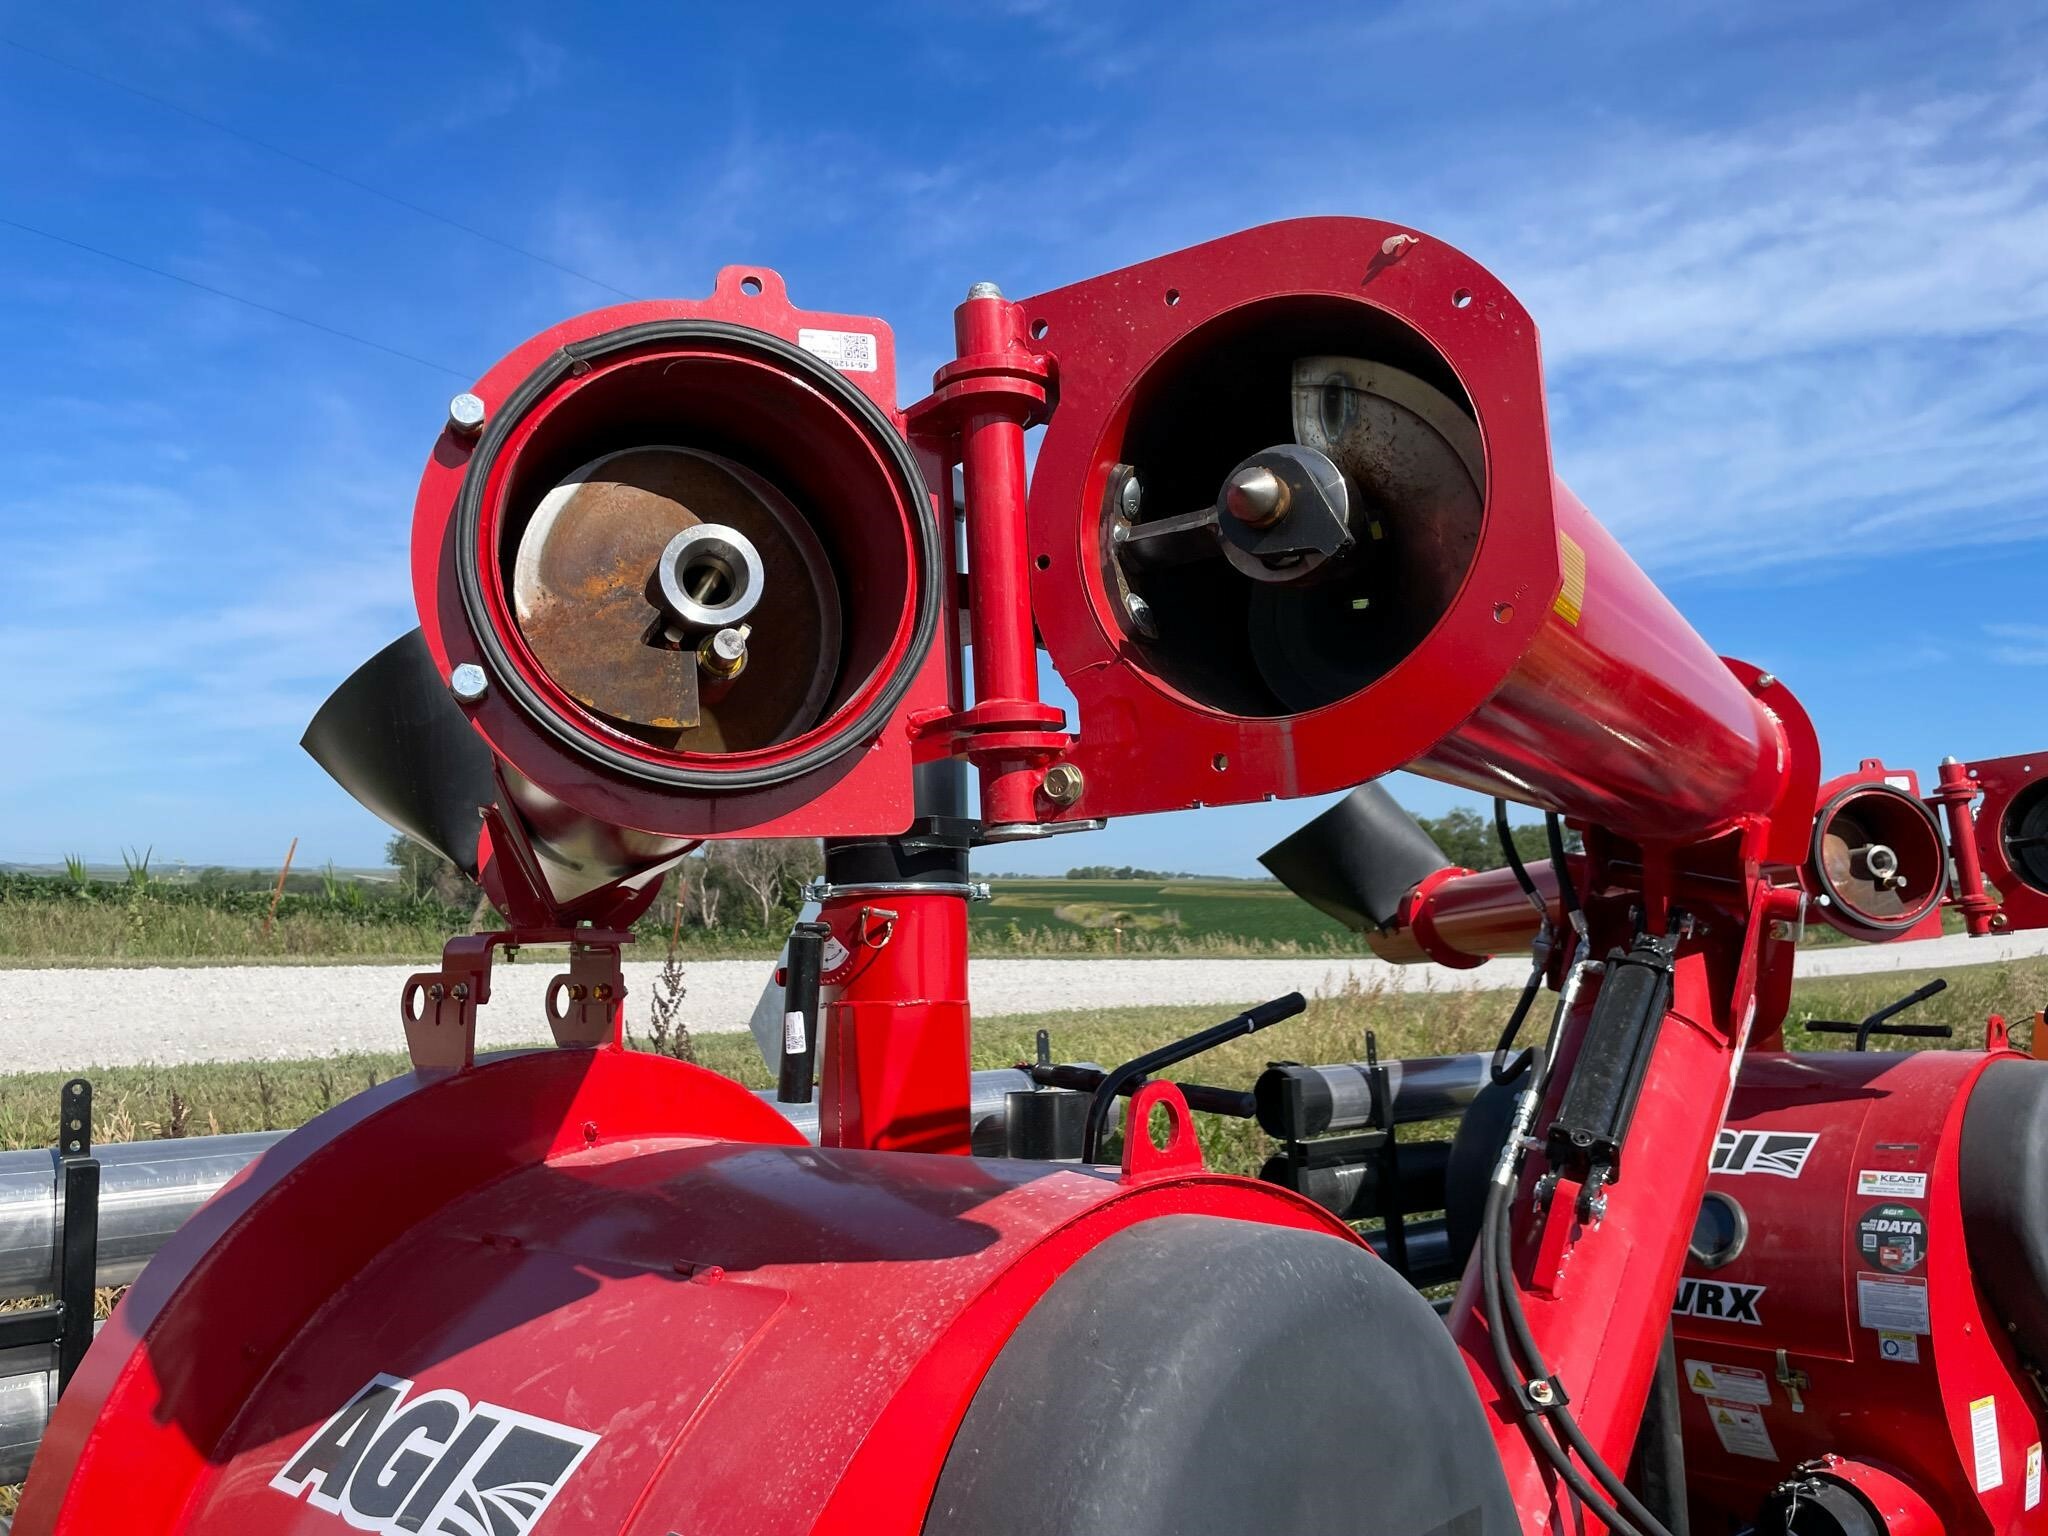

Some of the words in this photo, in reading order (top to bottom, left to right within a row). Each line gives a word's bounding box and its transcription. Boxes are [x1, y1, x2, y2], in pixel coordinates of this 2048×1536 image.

[1880, 1174, 1925, 1184] KEAST
[1876, 1219, 1922, 1235] DATA
[283, 1383, 500, 1533] AGI
